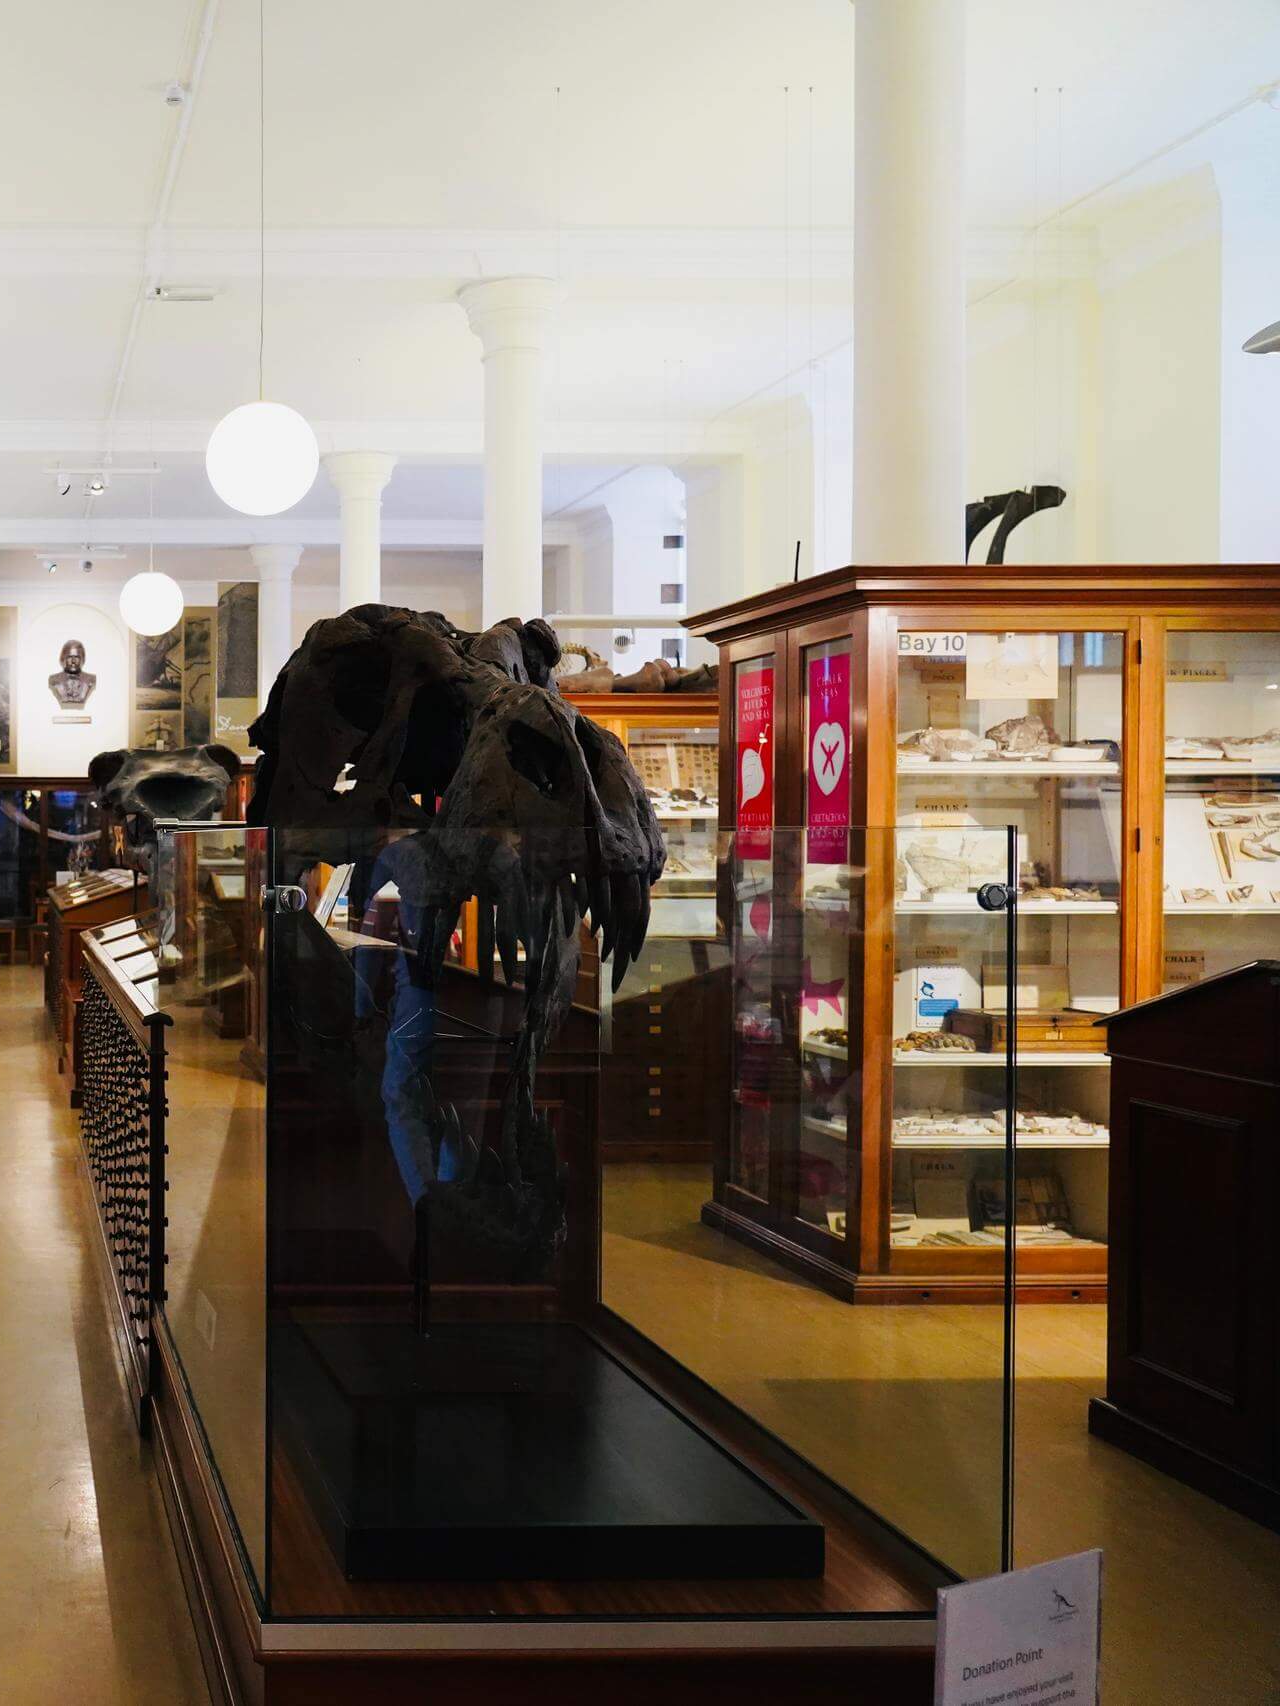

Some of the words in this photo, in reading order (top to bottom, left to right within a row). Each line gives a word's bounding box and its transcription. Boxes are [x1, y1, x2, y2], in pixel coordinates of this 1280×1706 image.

[898, 634, 937, 653] Bay
[942, 635, 965, 651] 10
[1165, 955, 1197, 963] CHALK
[962, 1657, 1013, 1681] Donation
[1015, 1648, 1044, 1665] Point
